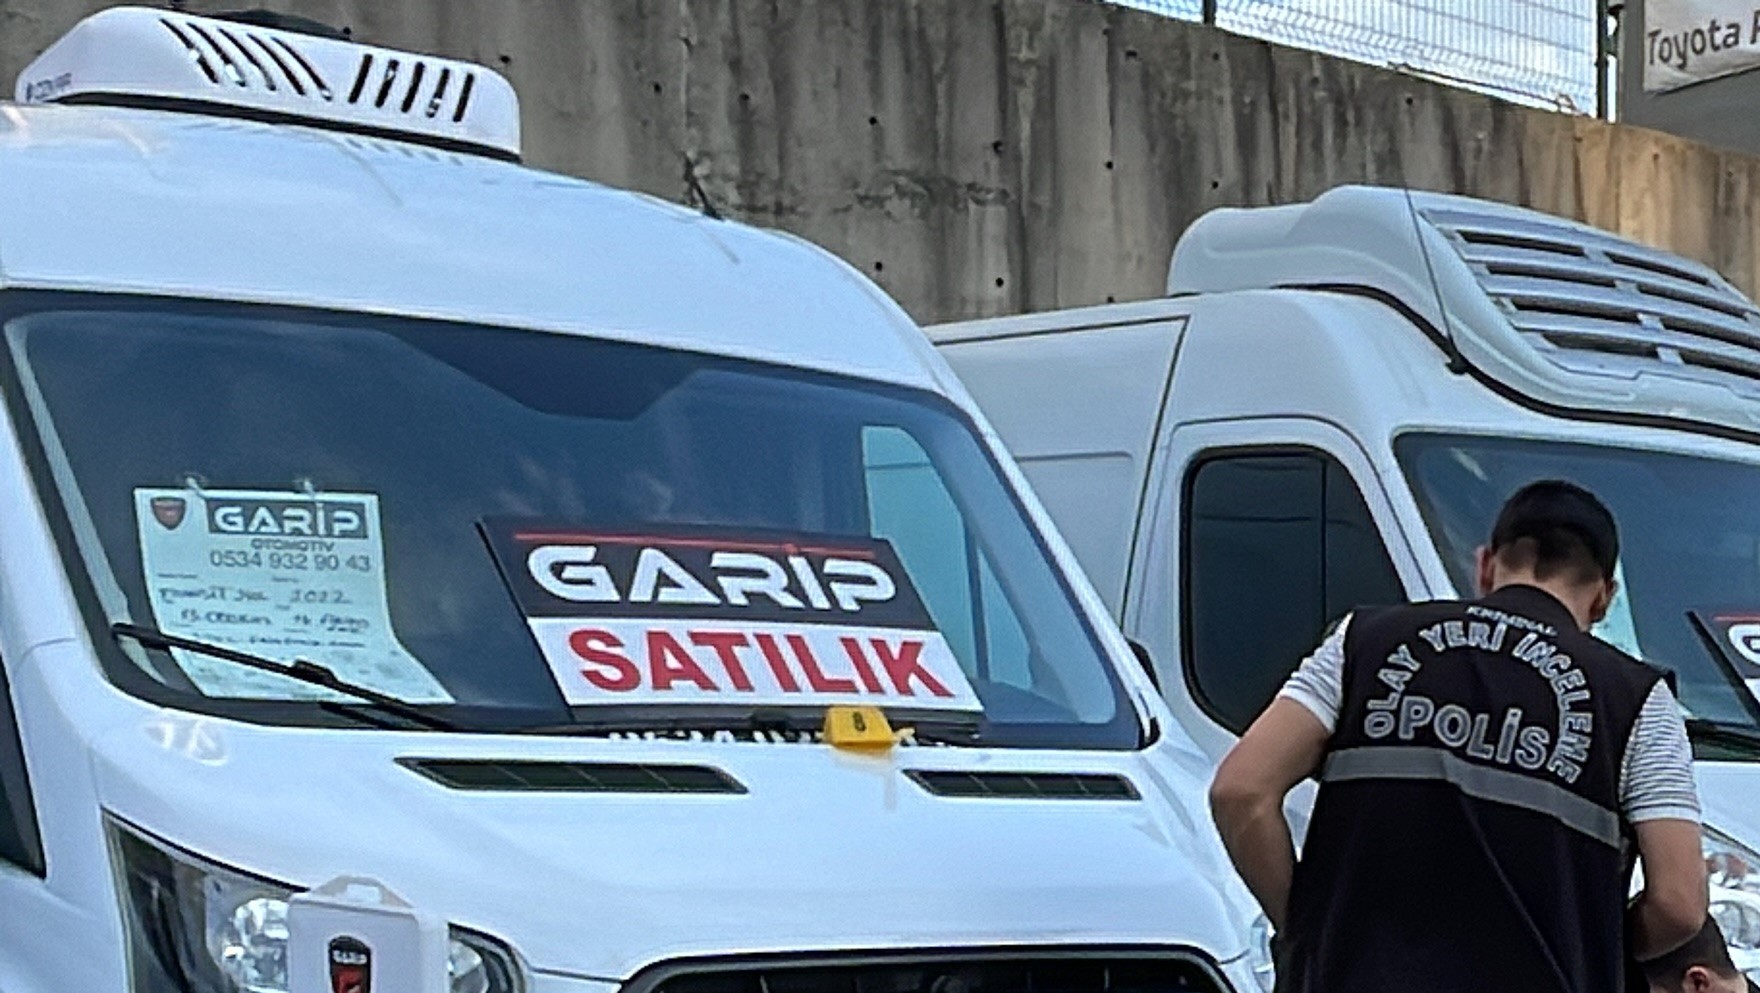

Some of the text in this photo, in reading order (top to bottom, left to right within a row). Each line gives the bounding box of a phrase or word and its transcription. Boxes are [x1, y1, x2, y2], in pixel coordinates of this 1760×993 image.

[1648, 18, 1740, 70] Toyota
[210, 550, 371, 572] 0534 932 90 43
[567, 628, 957, 699] SATILIK
[1363, 643, 1423, 740] OLAY
[1397, 695, 1551, 771] POLİS
